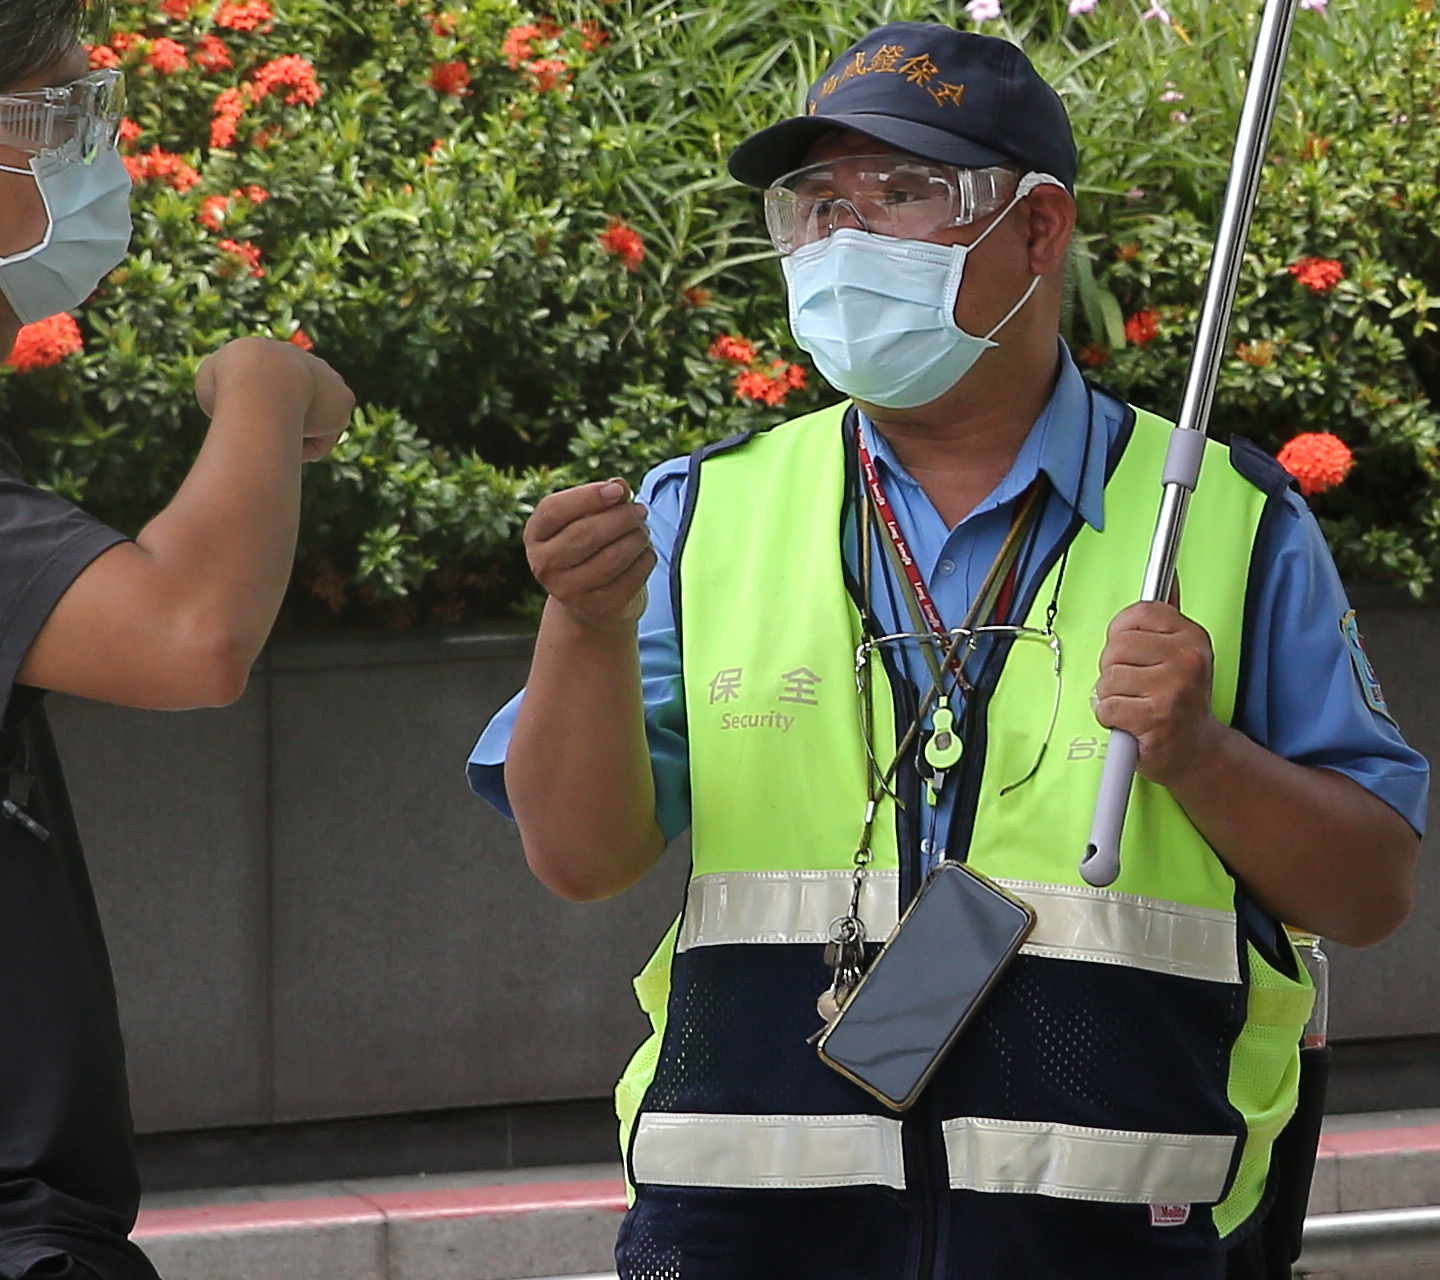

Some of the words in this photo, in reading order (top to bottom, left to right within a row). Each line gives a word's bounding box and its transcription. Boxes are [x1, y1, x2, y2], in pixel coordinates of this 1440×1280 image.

[887, 521, 900, 540] Long
[913, 581, 926, 601] Long
[709, 666, 822, 705] 保全
[720, 710, 795, 733] Security
[1067, 736, 1108, 760] 台
